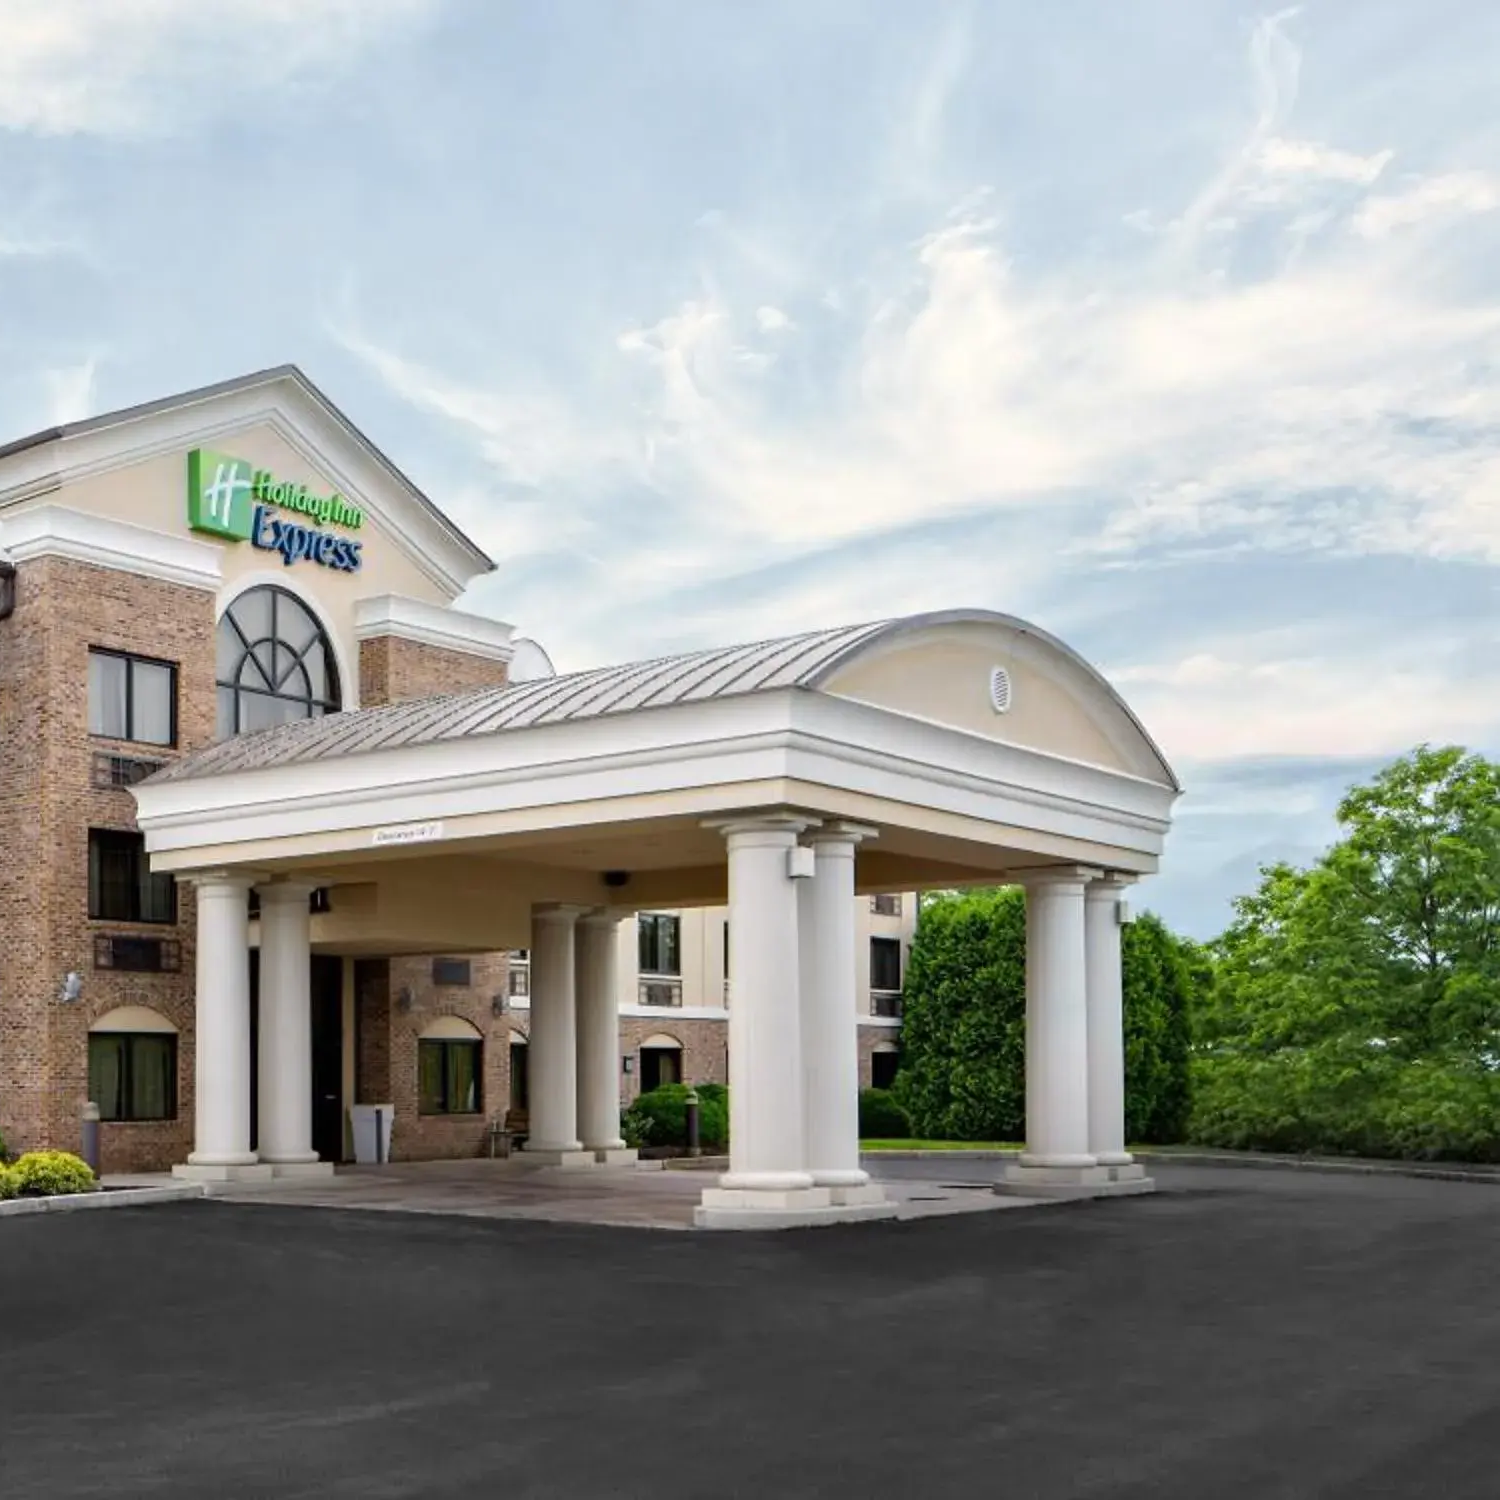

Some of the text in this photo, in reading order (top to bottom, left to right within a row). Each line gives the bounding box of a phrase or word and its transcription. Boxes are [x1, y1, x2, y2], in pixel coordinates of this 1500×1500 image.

[251, 470, 364, 529] Holiday Inn
[251, 504, 363, 573] Express
